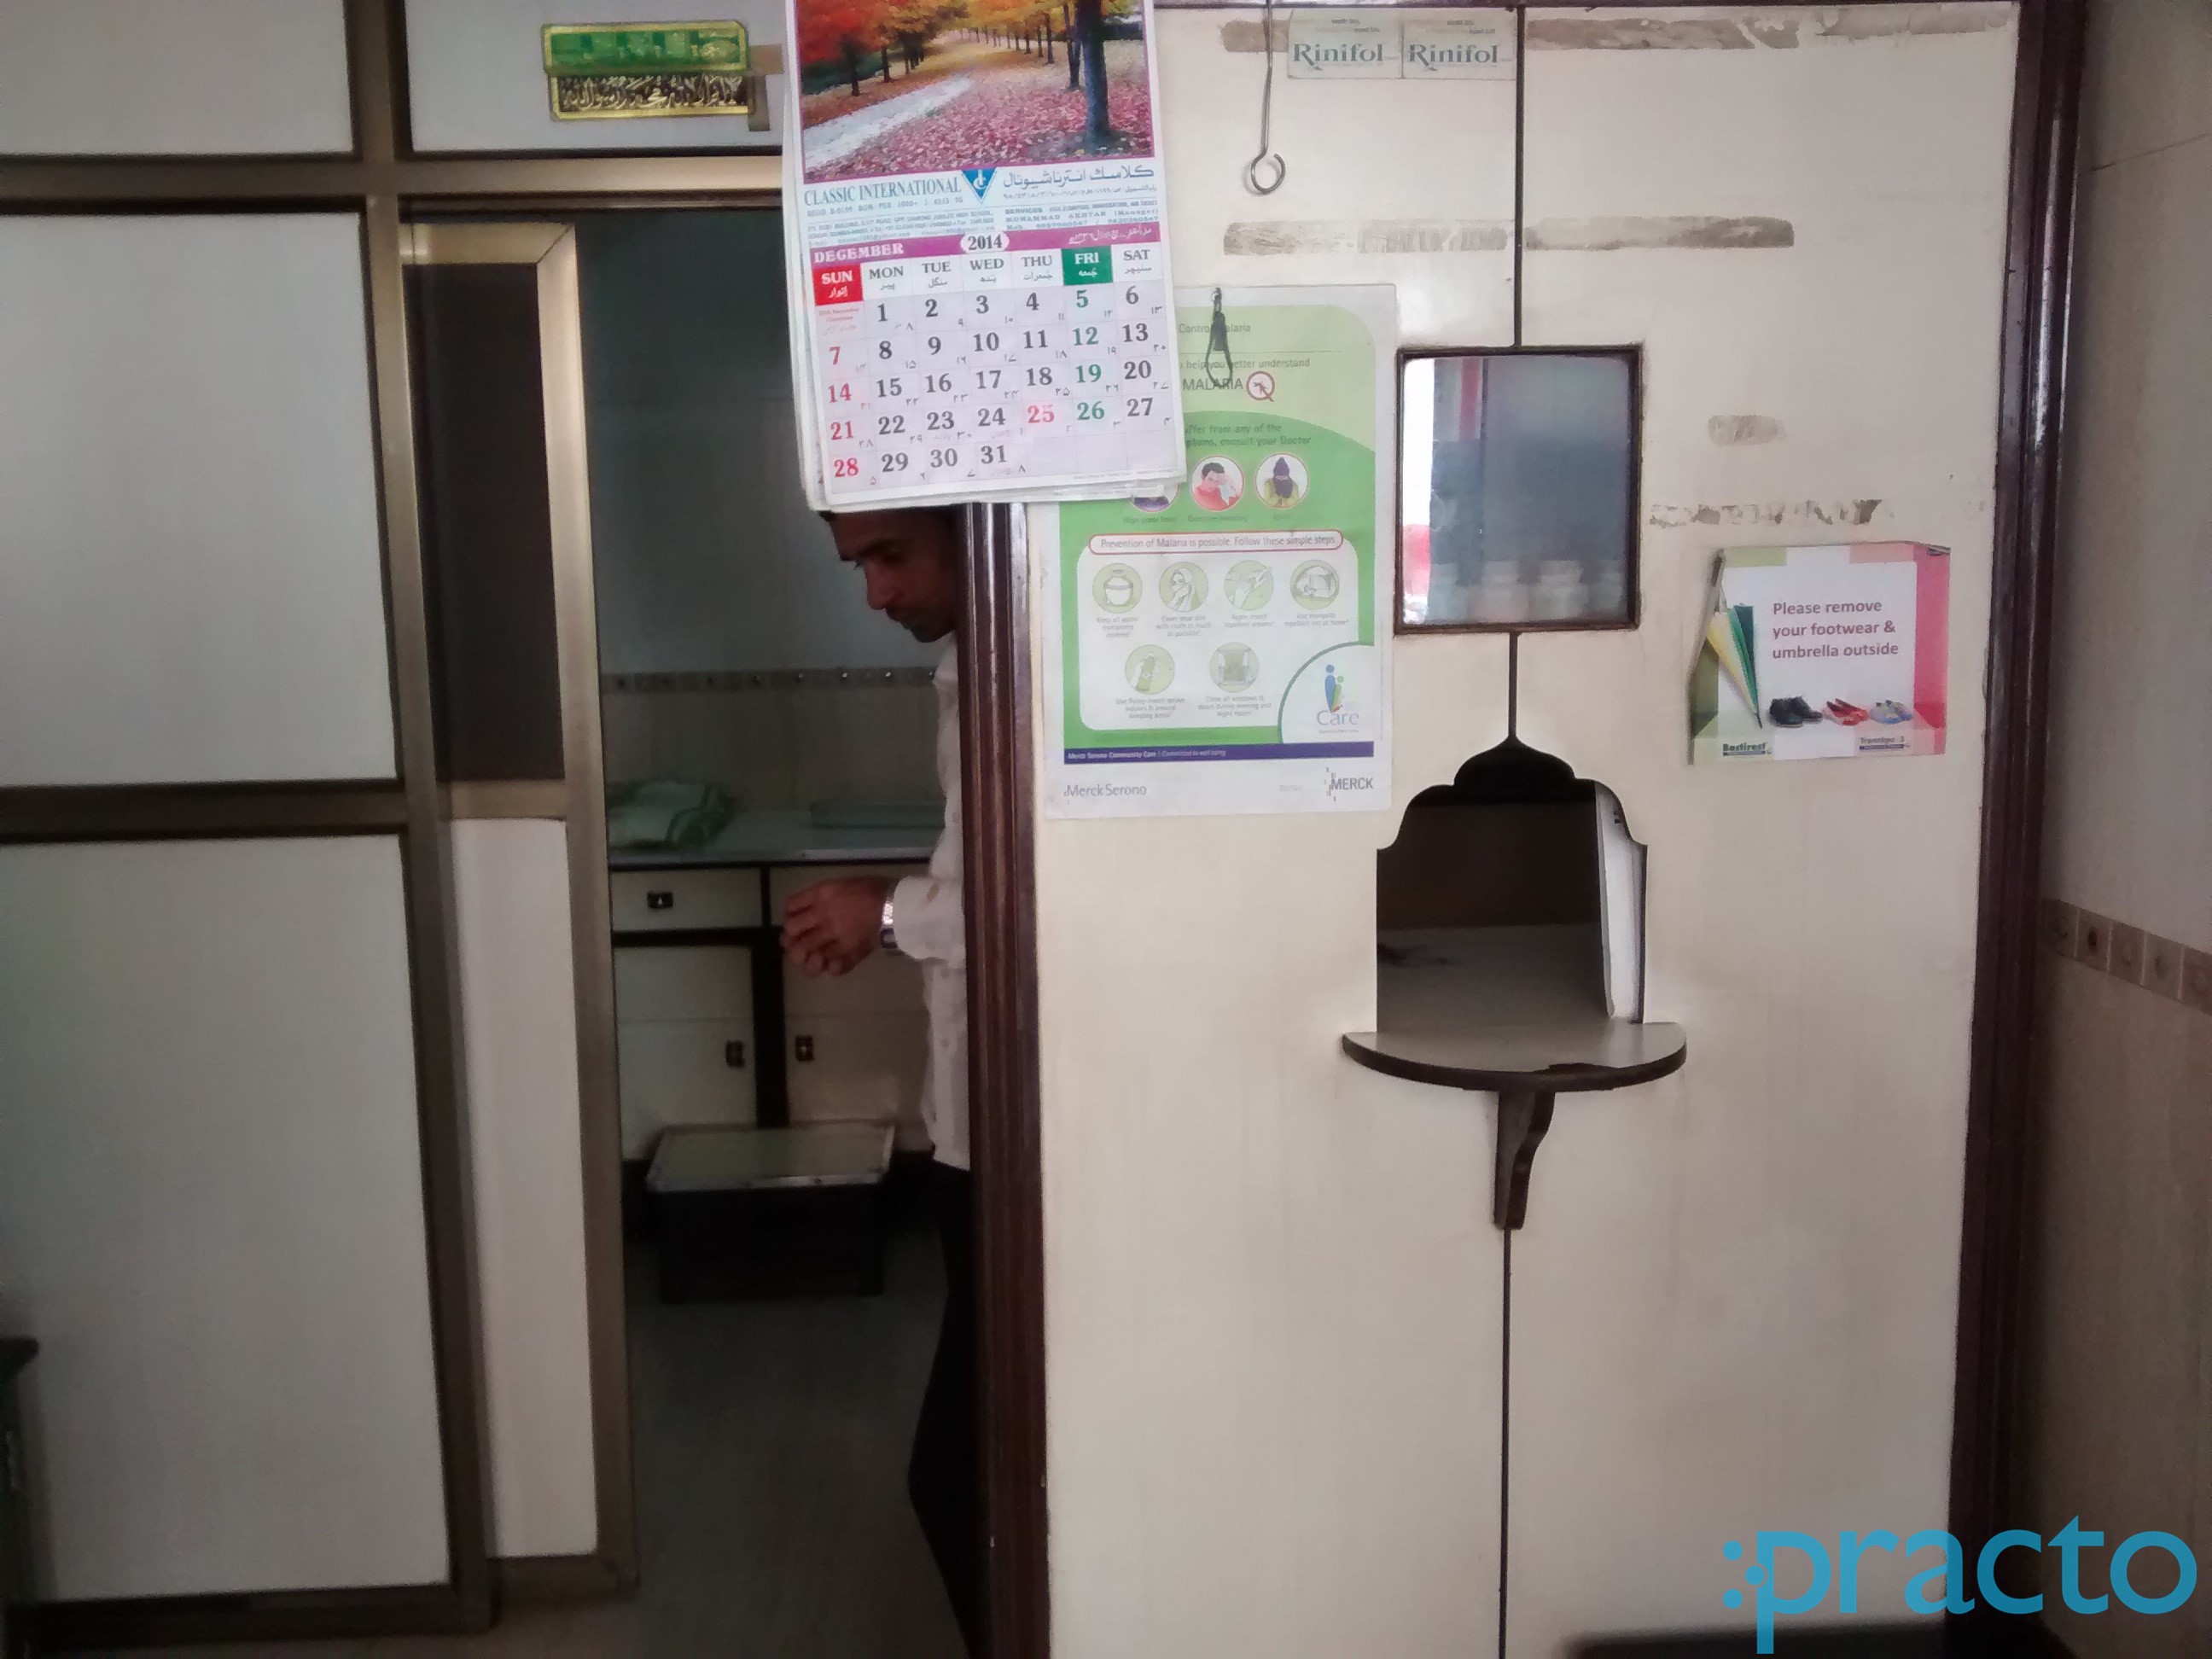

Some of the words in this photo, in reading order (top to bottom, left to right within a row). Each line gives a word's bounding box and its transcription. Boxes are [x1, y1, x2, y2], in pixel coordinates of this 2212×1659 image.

[1293, 44, 1383, 68] Rinifol
[1409, 44, 1499, 69] Rinifol
[804, 185, 855, 206] CLASSIC
[859, 178, 962, 200] INTERNATIONAL
[814, 242, 905, 263] DECEMBER
[968, 234, 1003, 251] 2014
[821, 270, 853, 284] SUN
[869, 266, 904, 280] MON
[922, 261, 952, 274] TUE
[969, 258, 1004, 271] WED
[1022, 255, 1052, 267] THU
[1074, 252, 1099, 265] FRI
[1123, 249, 1150, 261] SAT
[877, 303, 888, 322] 1
[925, 299, 938, 317] 2
[975, 295, 989, 313] 3
[1026, 293, 1039, 310] 4
[1076, 289, 1088, 308] 5
[1126, 285, 1138, 304] 6
[1179, 323, 1212, 333] Contro
[1225, 323, 1251, 333] alaria
[829, 346, 841, 365] 7
[879, 341, 892, 359] 8
[928, 336, 941, 355] 9
[973, 332, 999, 351] 10
[1023, 329, 1048, 348] 11
[1073, 327, 1098, 346] 12
[1122, 323, 1149, 342] 13
[1209, 362, 1225, 370] you
[1258, 358, 1311, 368] understand
[828, 383, 852, 403] 14
[876, 378, 902, 398] 15
[926, 373, 952, 393] 16
[975, 370, 1001, 389] 17
[1026, 367, 1052, 386] 18
[1075, 364, 1102, 382] 19
[1124, 360, 1151, 379] 20
[1183, 378, 1243, 390] MALARIA
[830, 420, 853, 440] 21
[878, 415, 905, 434] 22
[927, 410, 954, 430] 23
[978, 407, 1005, 426] 24
[1027, 404, 1055, 423] 25
[1077, 401, 1104, 420] 26
[1126, 398, 1153, 416] 27
[1235, 426, 1249, 434] any
[1254, 423, 1264, 433] of
[1267, 424, 1281, 433] the
[1257, 438, 1277, 447] your
[1280, 435, 1311, 445] Doctor
[834, 457, 859, 477] 28
[881, 452, 908, 472] 29
[930, 448, 958, 468] 30
[981, 445, 1006, 463] 31
[1101, 538, 1142, 549] Prevention
[1145, 538, 1155, 547] of
[1157, 538, 1187, 548] Malaria
[1190, 538, 1196, 547] is
[1198, 537, 1232, 549] possible.
[1235, 536, 1260, 546] Follow
[1263, 536, 1284, 545] these
[1286, 535, 1313, 547] simple
[1315, 536, 1335, 546] steps
[1773, 602, 1821, 615] Please
[1825, 602, 1883, 614] remove
[1773, 626, 1807, 640] your
[1810, 623, 1880, 636] footwear
[1883, 620, 1896, 633] &
[1773, 644, 1839, 659] umbrella
[1842, 643, 1899, 656] outside
[1317, 710, 1359, 725] Care
[1067, 784, 1103, 797] Merck
[1105, 783, 1147, 796] Serono
[1331, 777, 1374, 790] MERCK
